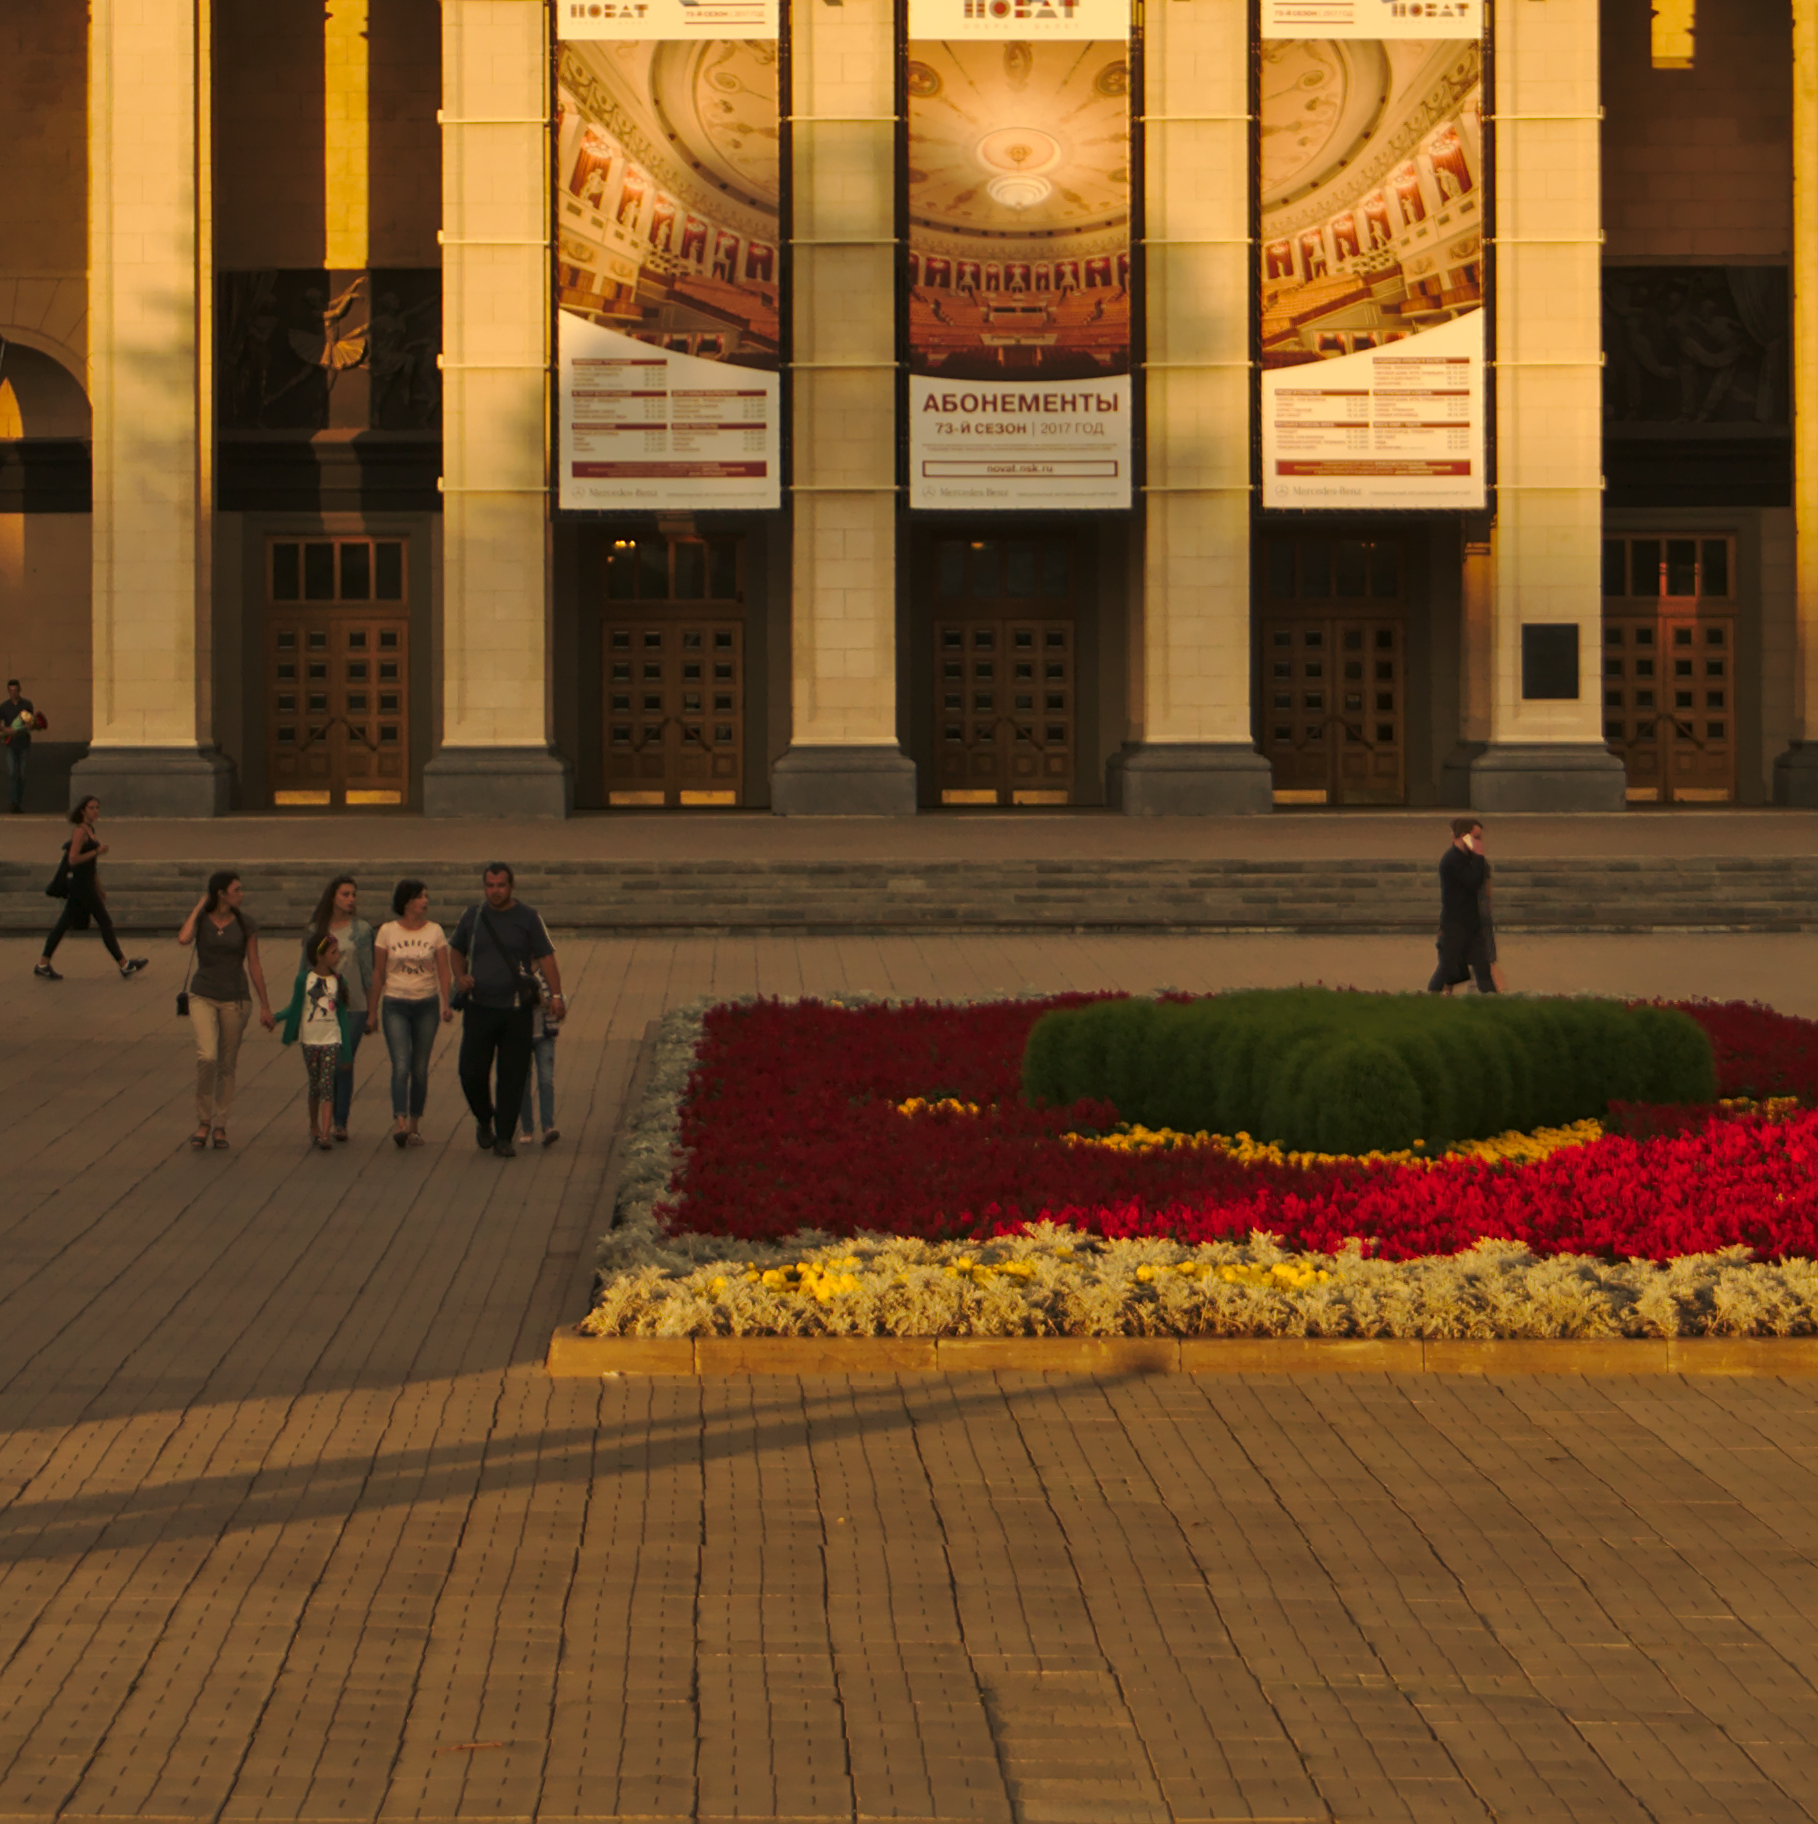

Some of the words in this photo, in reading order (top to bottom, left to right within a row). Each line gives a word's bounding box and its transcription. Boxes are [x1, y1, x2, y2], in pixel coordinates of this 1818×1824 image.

[922, 392, 1118, 413] АБОНЕМЕНТЫ
[935, 420, 970, 434] 73-Й
[974, 422, 1027, 435] СЕЗОН
[1040, 422, 1070, 434] 2017
[1074, 422, 1105, 436] ГОД
[987, 463, 1053, 473] novat.nsk.ru
[1293, 486, 1361, 496] Mercedes-Benz
